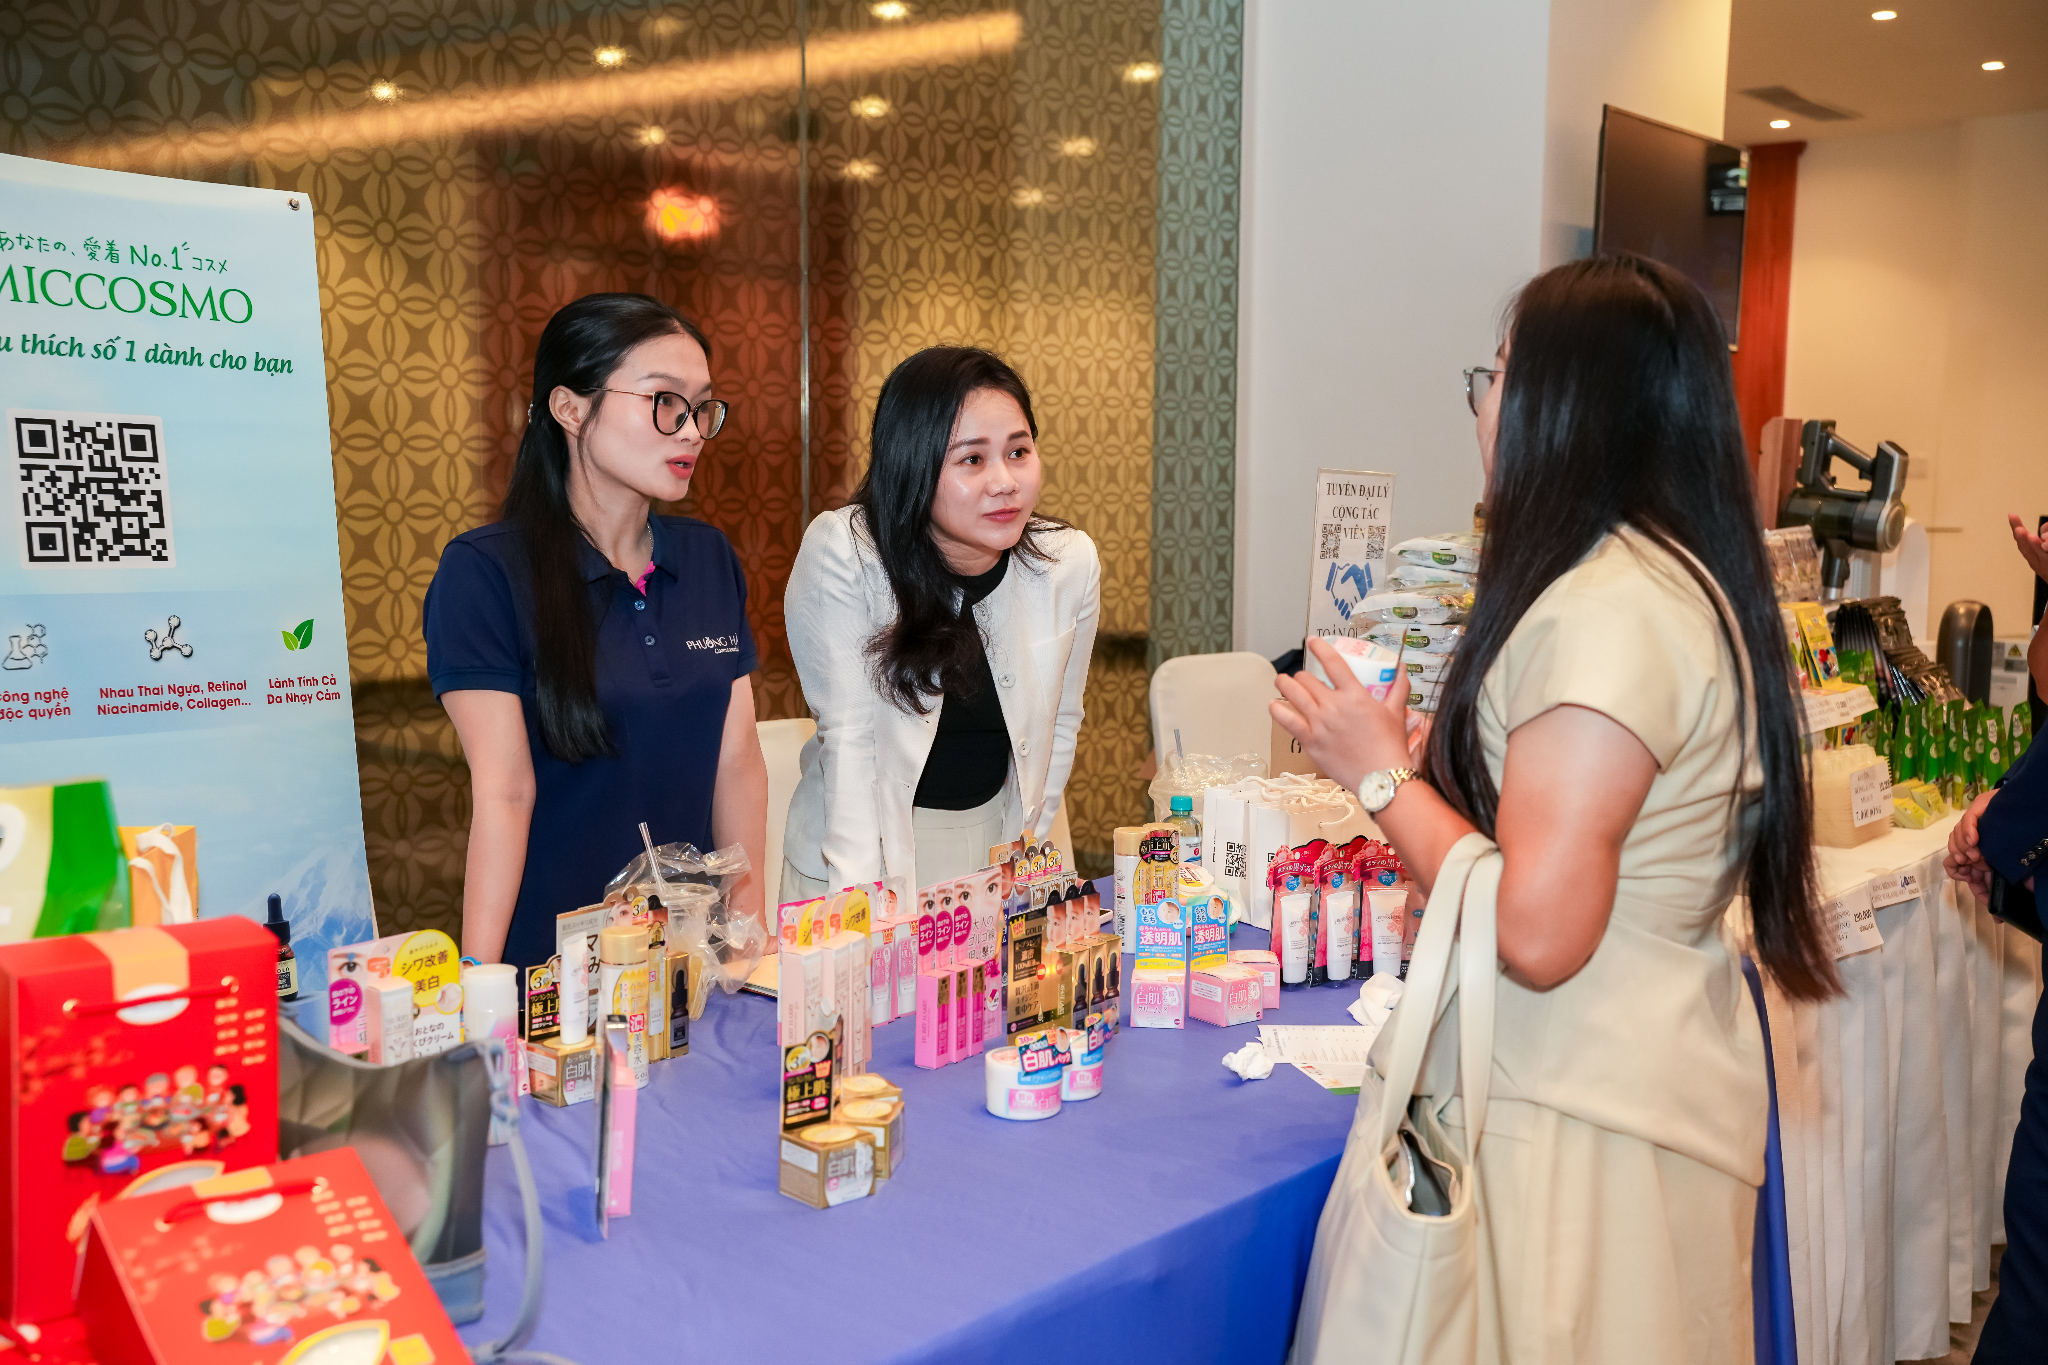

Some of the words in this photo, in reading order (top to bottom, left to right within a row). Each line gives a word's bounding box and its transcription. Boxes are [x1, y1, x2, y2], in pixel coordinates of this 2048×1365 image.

[192, 256, 228, 274] コスメ
[21, 333, 86, 358] thích
[91, 336, 121, 360] số
[125, 340, 137, 363] 1
[144, 342, 204, 367] dành
[209, 349, 247, 371] cho
[253, 352, 294, 377] bạn
[1376, 482, 1389, 498] LÝ
[1332, 504, 1359, 522] CỘNG
[1361, 503, 1380, 520] TÁC
[1343, 524, 1366, 540] VIÊN
[99, 687, 134, 699] Nhau
[138, 684, 164, 697] Thai
[168, 683, 204, 698] Ngựa,
[207, 680, 247, 692] Retinol
[269, 677, 295, 689] Lành
[297, 675, 319, 687] Tính
[321, 673, 337, 686] Cả
[0, 689, 30, 704] ông
[34, 687, 70, 703] nghệ
[267, 693, 282, 705] Da
[286, 692, 313, 705] Nhạy
[316, 688, 341, 702] Cảm
[28, 703, 71, 720] quyền
[97, 699, 183, 716] Niacinamide,
[972, 915, 994, 931] 大人の
[1025, 925, 1042, 936] GOLD
[1140, 931, 1183, 946] 透明肌
[1194, 926, 1226, 945] 透明肌
[401, 949, 449, 976] シワ改善
[415, 975, 440, 995] 美白
[332, 995, 358, 1009] ライン
[1136, 991, 1162, 1005] 白肌
[1229, 989, 1248, 1005] 白肌
[414, 1022, 446, 1036] おとなの
[565, 1061, 590, 1080] 白肌
